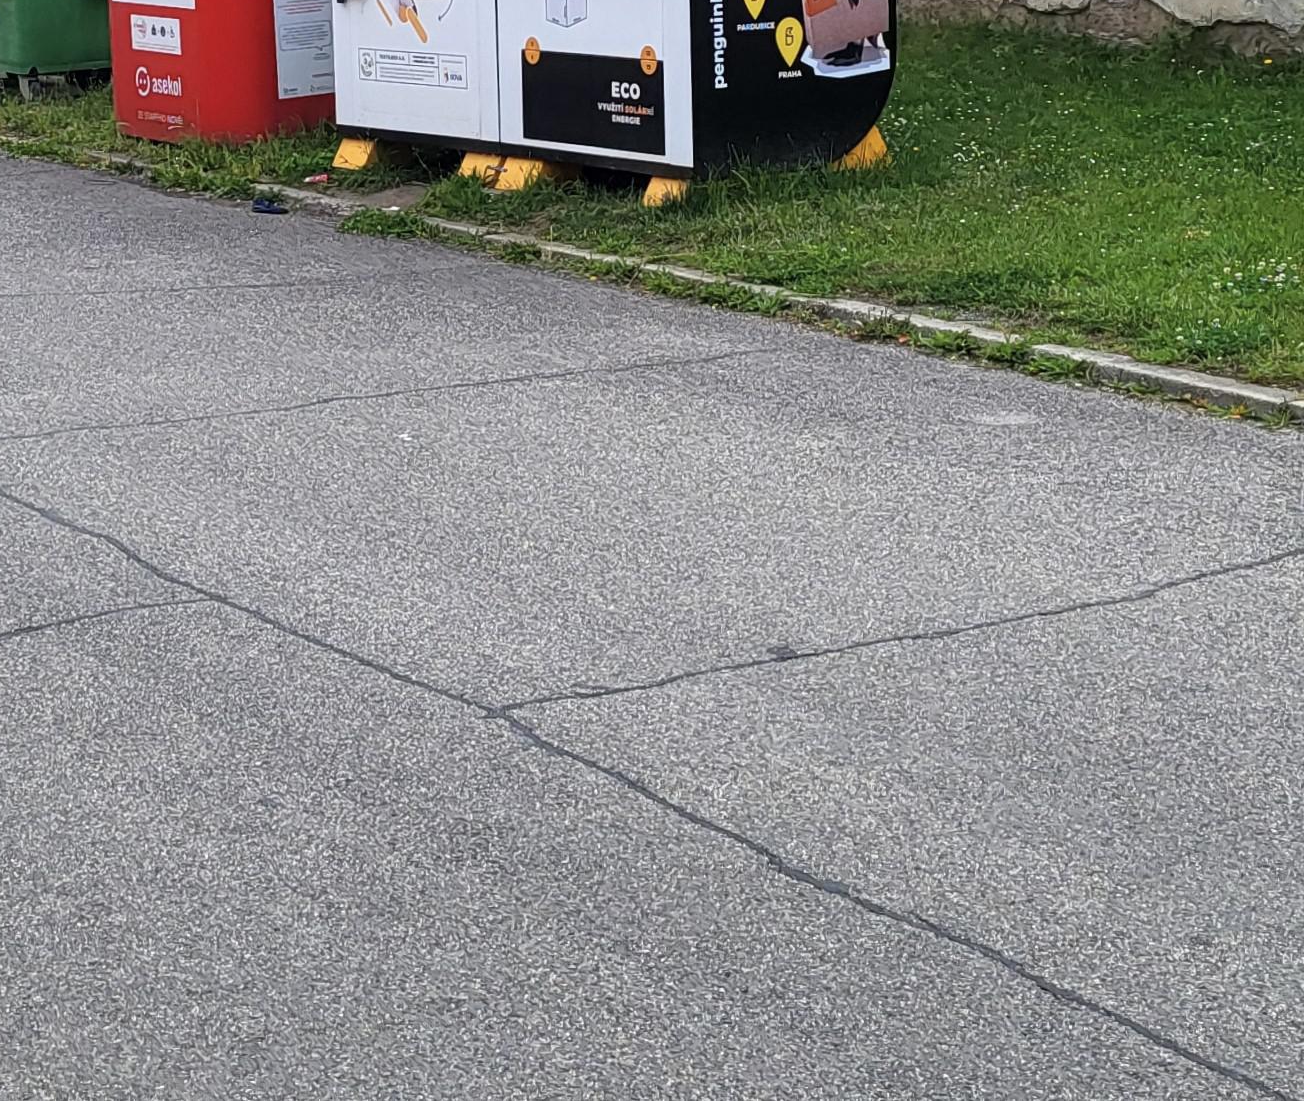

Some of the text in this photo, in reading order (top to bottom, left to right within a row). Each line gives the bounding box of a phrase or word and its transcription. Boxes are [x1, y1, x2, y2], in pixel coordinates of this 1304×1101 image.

[778, 69, 802, 79] PRAHA
[152, 74, 182, 97] asekol
[611, 80, 641, 100] ECO
[597, 101, 624, 113] VYUŽITÍ
[611, 114, 641, 125] ENERGIE
